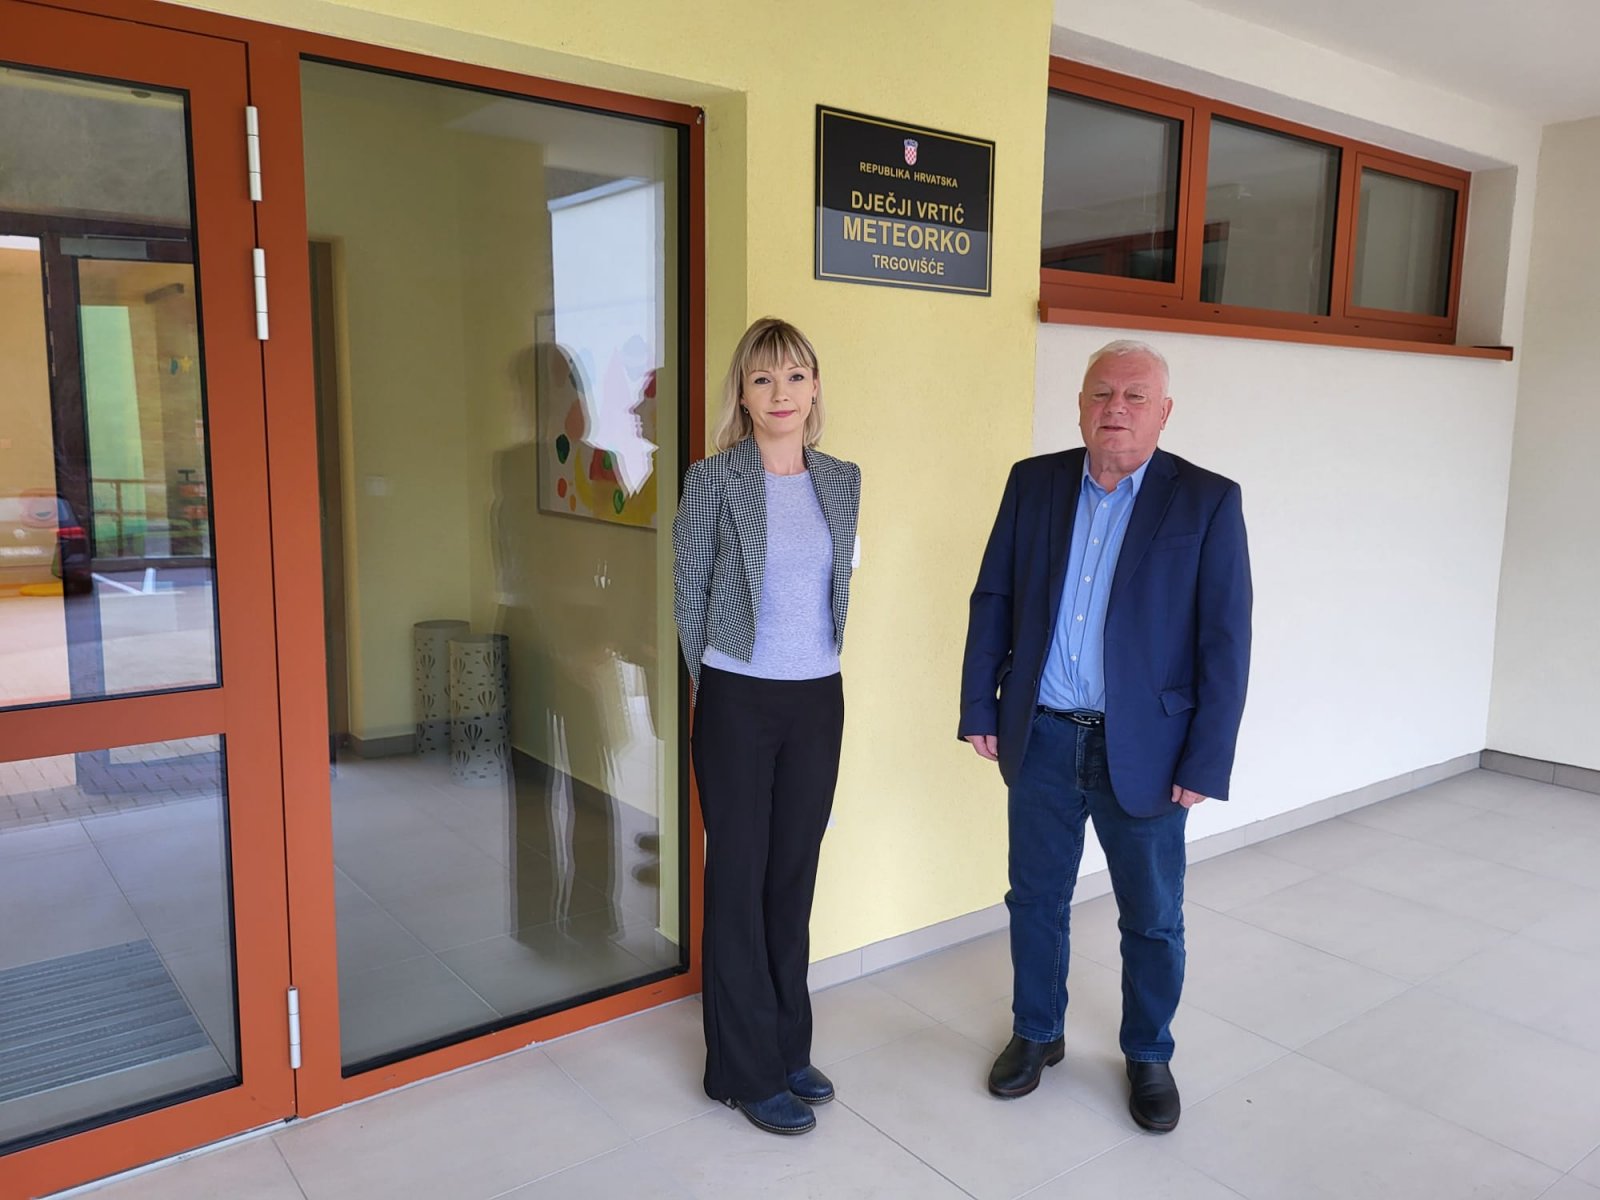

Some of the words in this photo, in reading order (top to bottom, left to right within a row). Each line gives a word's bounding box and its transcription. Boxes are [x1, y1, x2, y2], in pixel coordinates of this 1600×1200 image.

[859, 161, 911, 180] REPUBLIKA
[913, 171, 958, 188] HRVATSKA
[851, 190, 912, 217] DJEČJI
[916, 200, 965, 225] VRTIĆ
[843, 215, 971, 256] METEORKO
[872, 254, 945, 276] TRGOVIŠĆE
